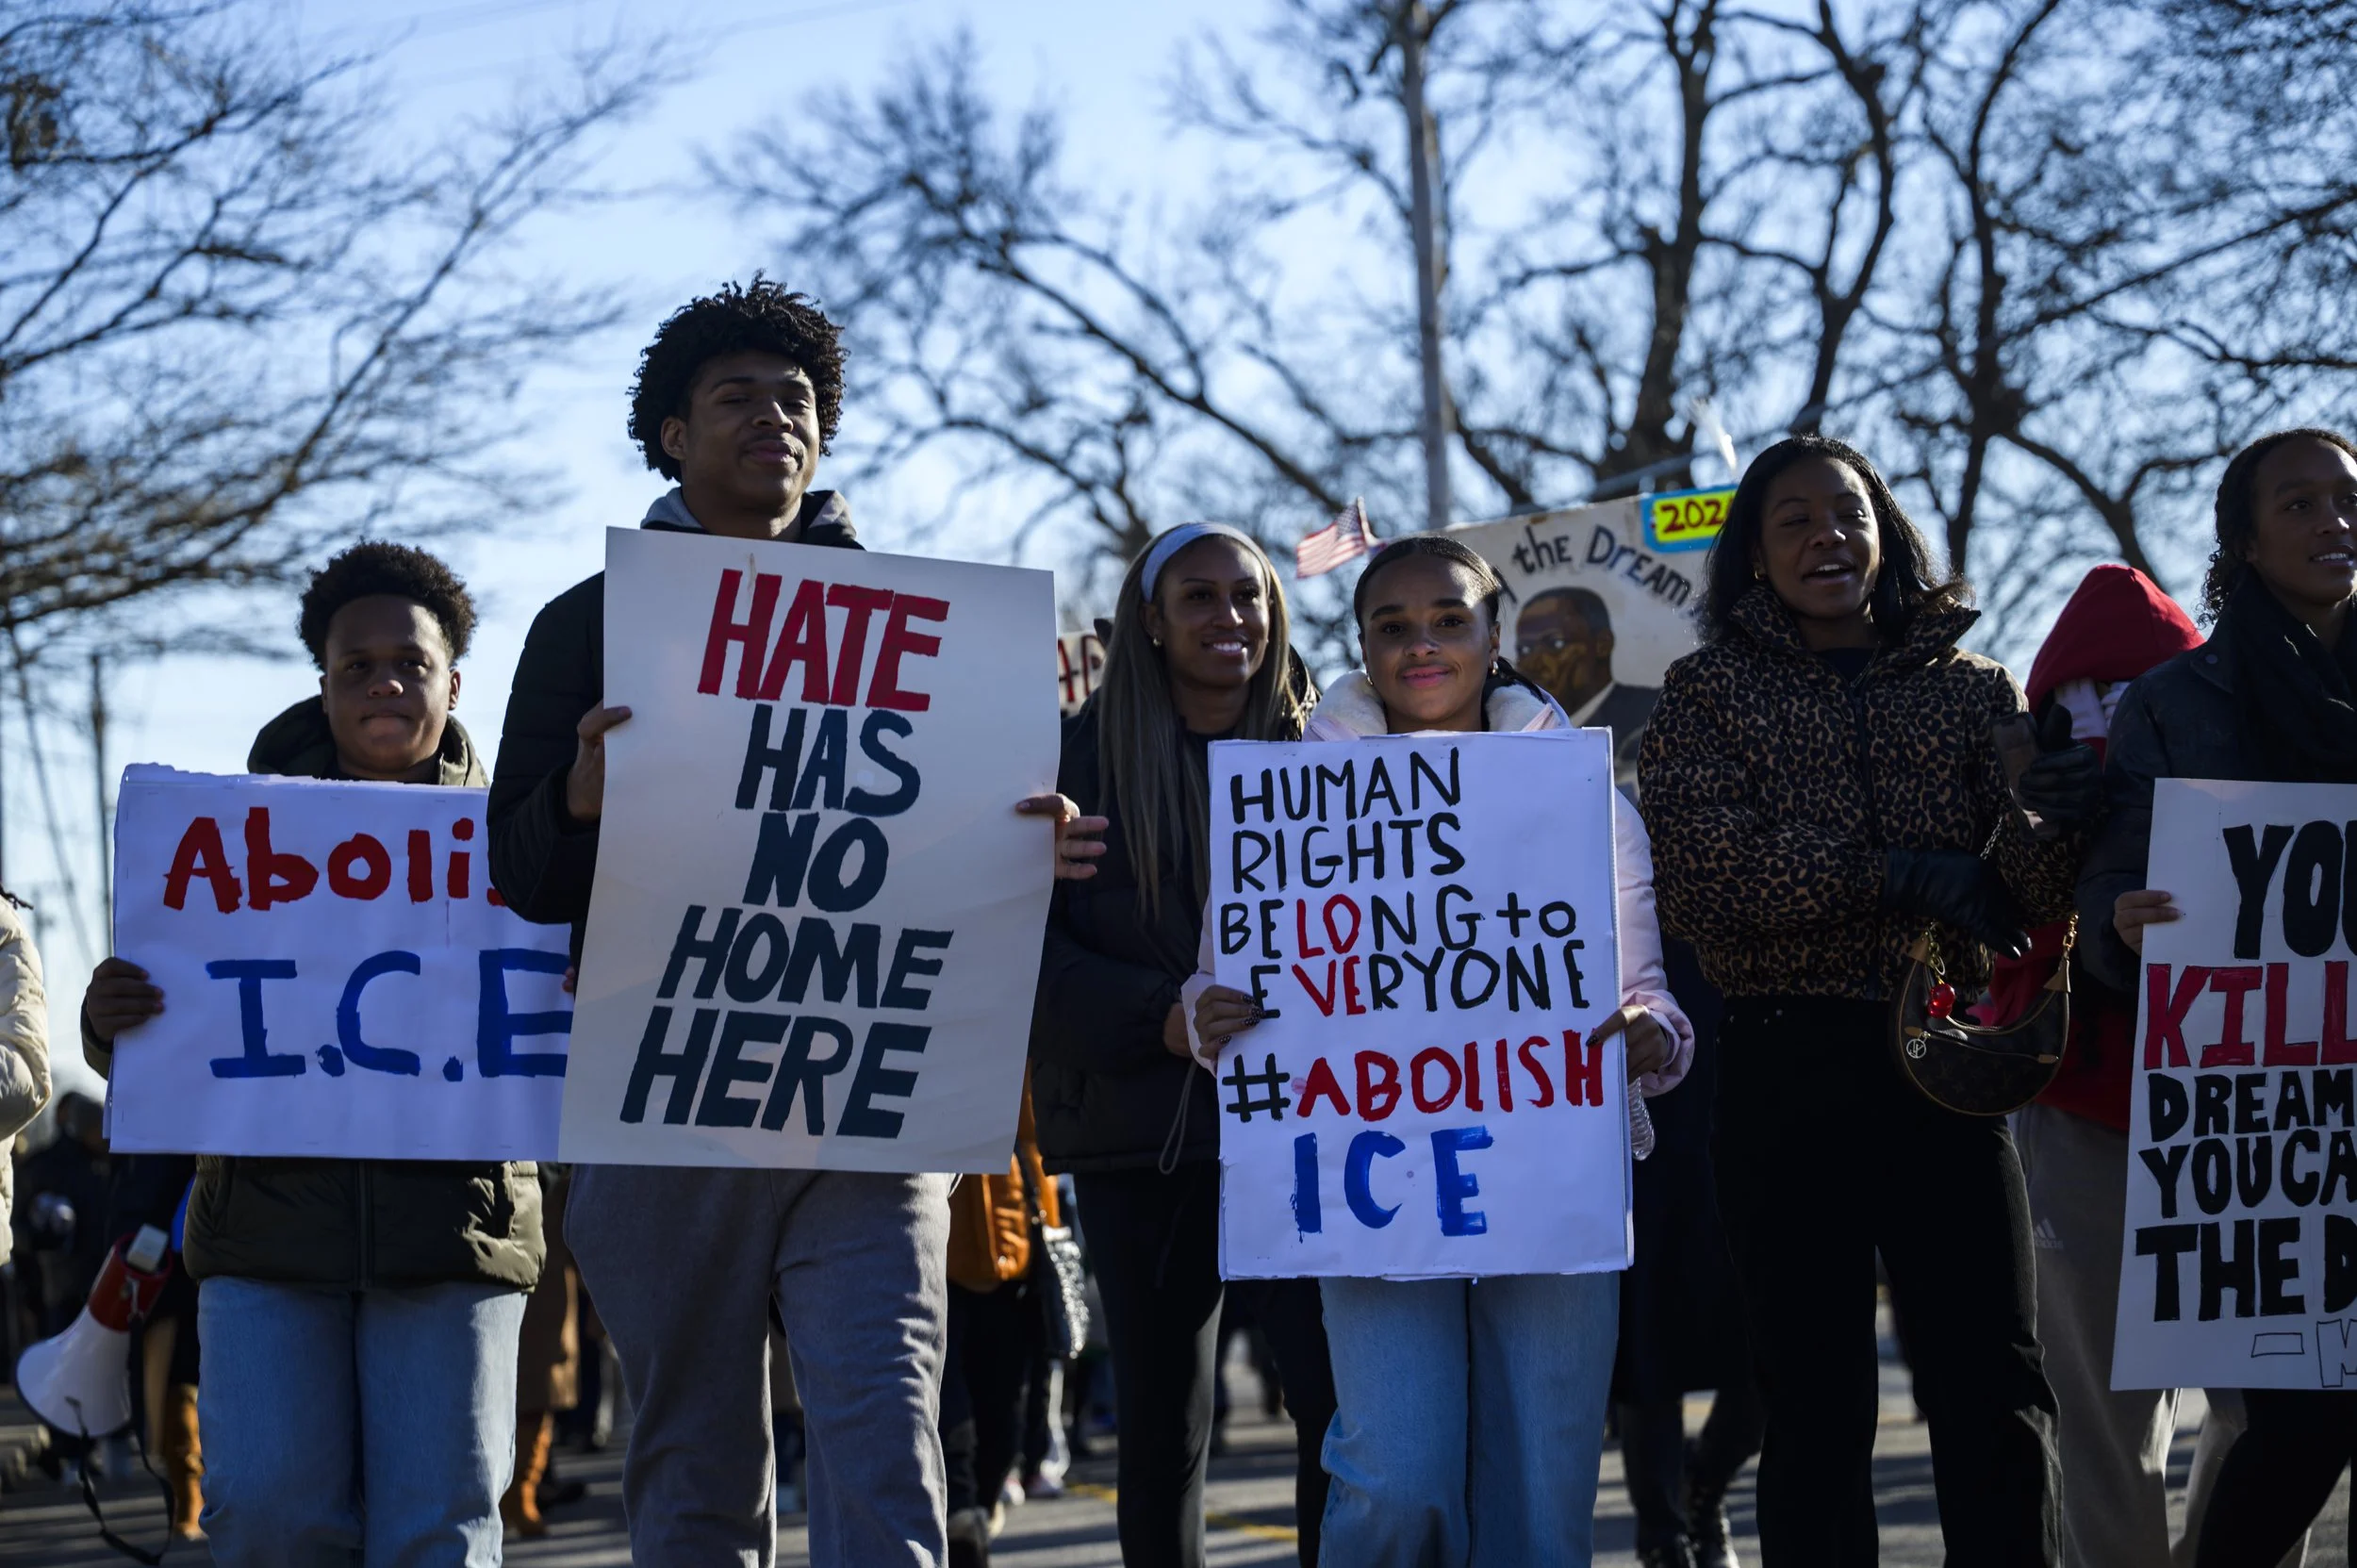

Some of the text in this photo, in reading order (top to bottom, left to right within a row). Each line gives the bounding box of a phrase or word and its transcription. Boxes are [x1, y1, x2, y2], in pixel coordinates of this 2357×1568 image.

[698, 569, 949, 712] HATE
[734, 703, 920, 817] HAS
[1230, 747, 1460, 824] HUMAN
[163, 807, 506, 913] Aboli
[742, 812, 889, 912] NO
[1232, 812, 1466, 893] RIGHTS
[2223, 820, 2357, 959] YO
[656, 905, 953, 1010] HOME
[1221, 883, 1576, 960] BELONG to
[1250, 940, 1590, 1019] EVERYONE
[619, 1006, 931, 1139] HERE
[2149, 1068, 2354, 1142] DREAM
[1291, 1124, 1494, 1242] ICE
[2136, 1217, 2306, 1321] THE
